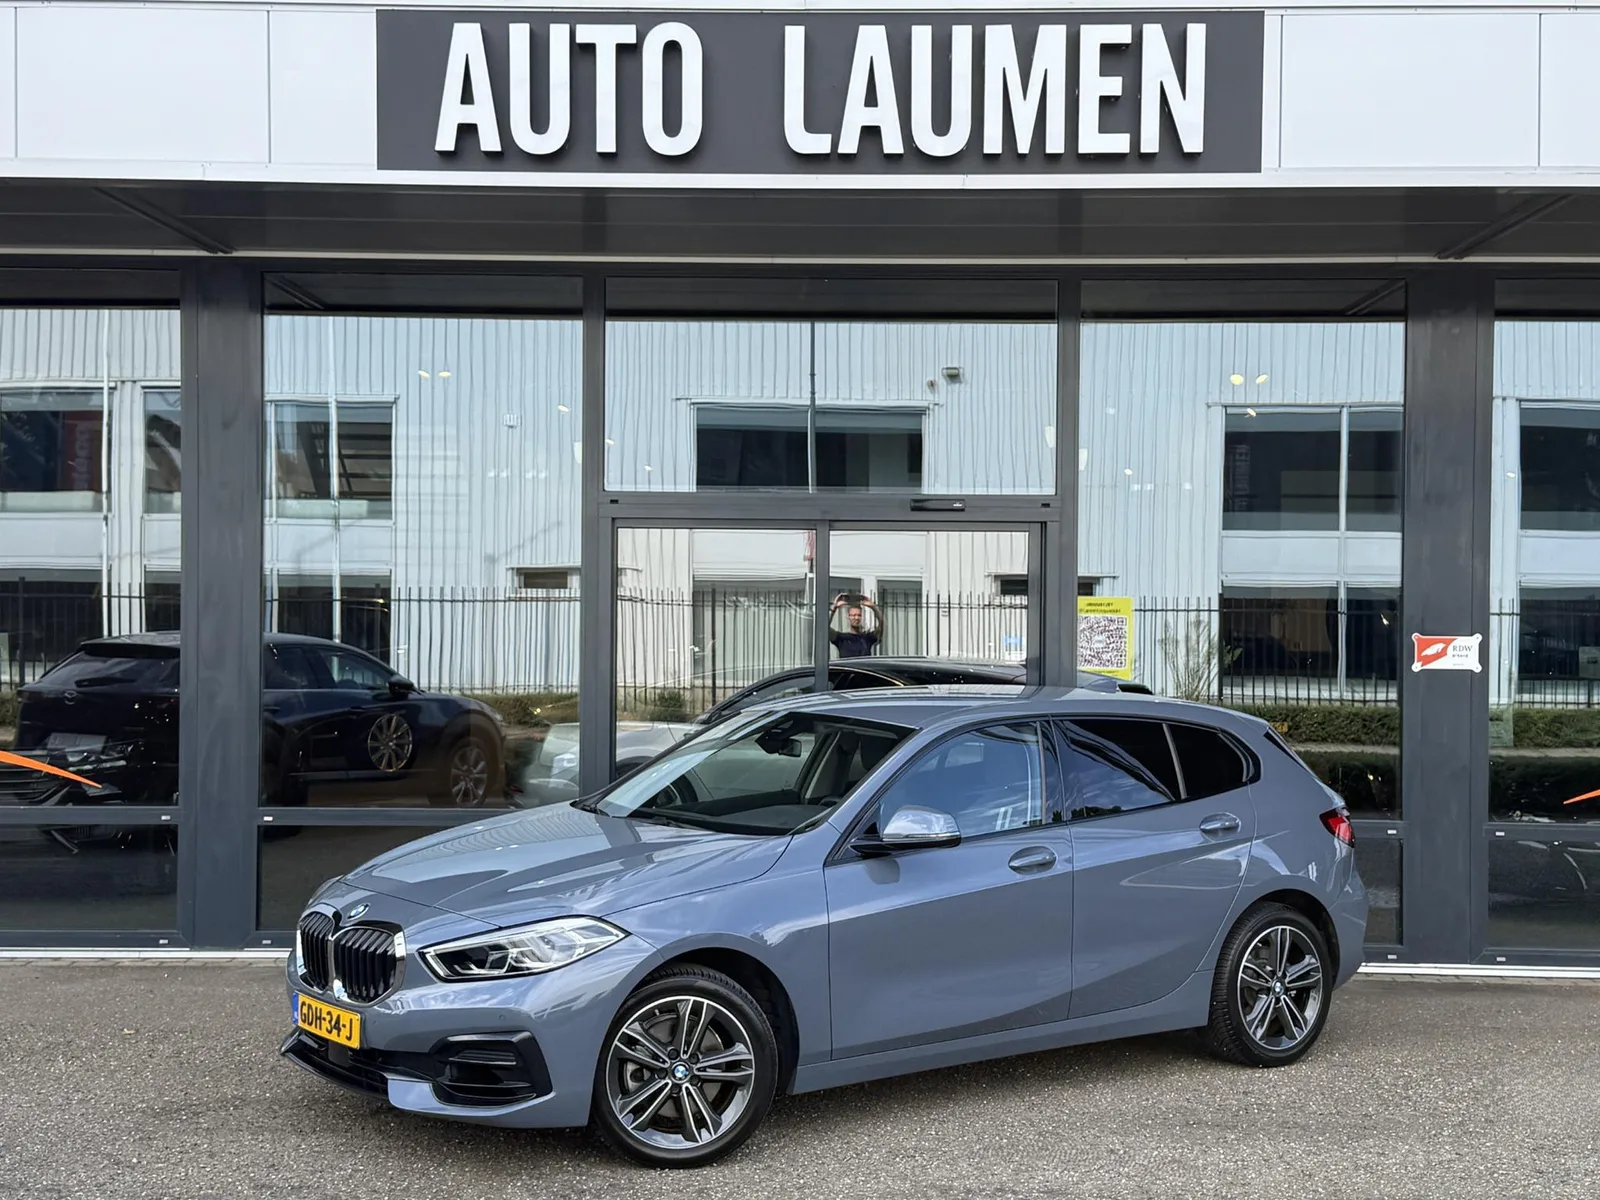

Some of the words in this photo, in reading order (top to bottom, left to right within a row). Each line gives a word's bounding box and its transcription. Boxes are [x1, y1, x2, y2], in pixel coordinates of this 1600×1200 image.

[435, 22, 703, 156] AUTO
[784, 22, 1207, 157] LAUMEN
[300, 1000, 353, 1042] GDH-34-J
